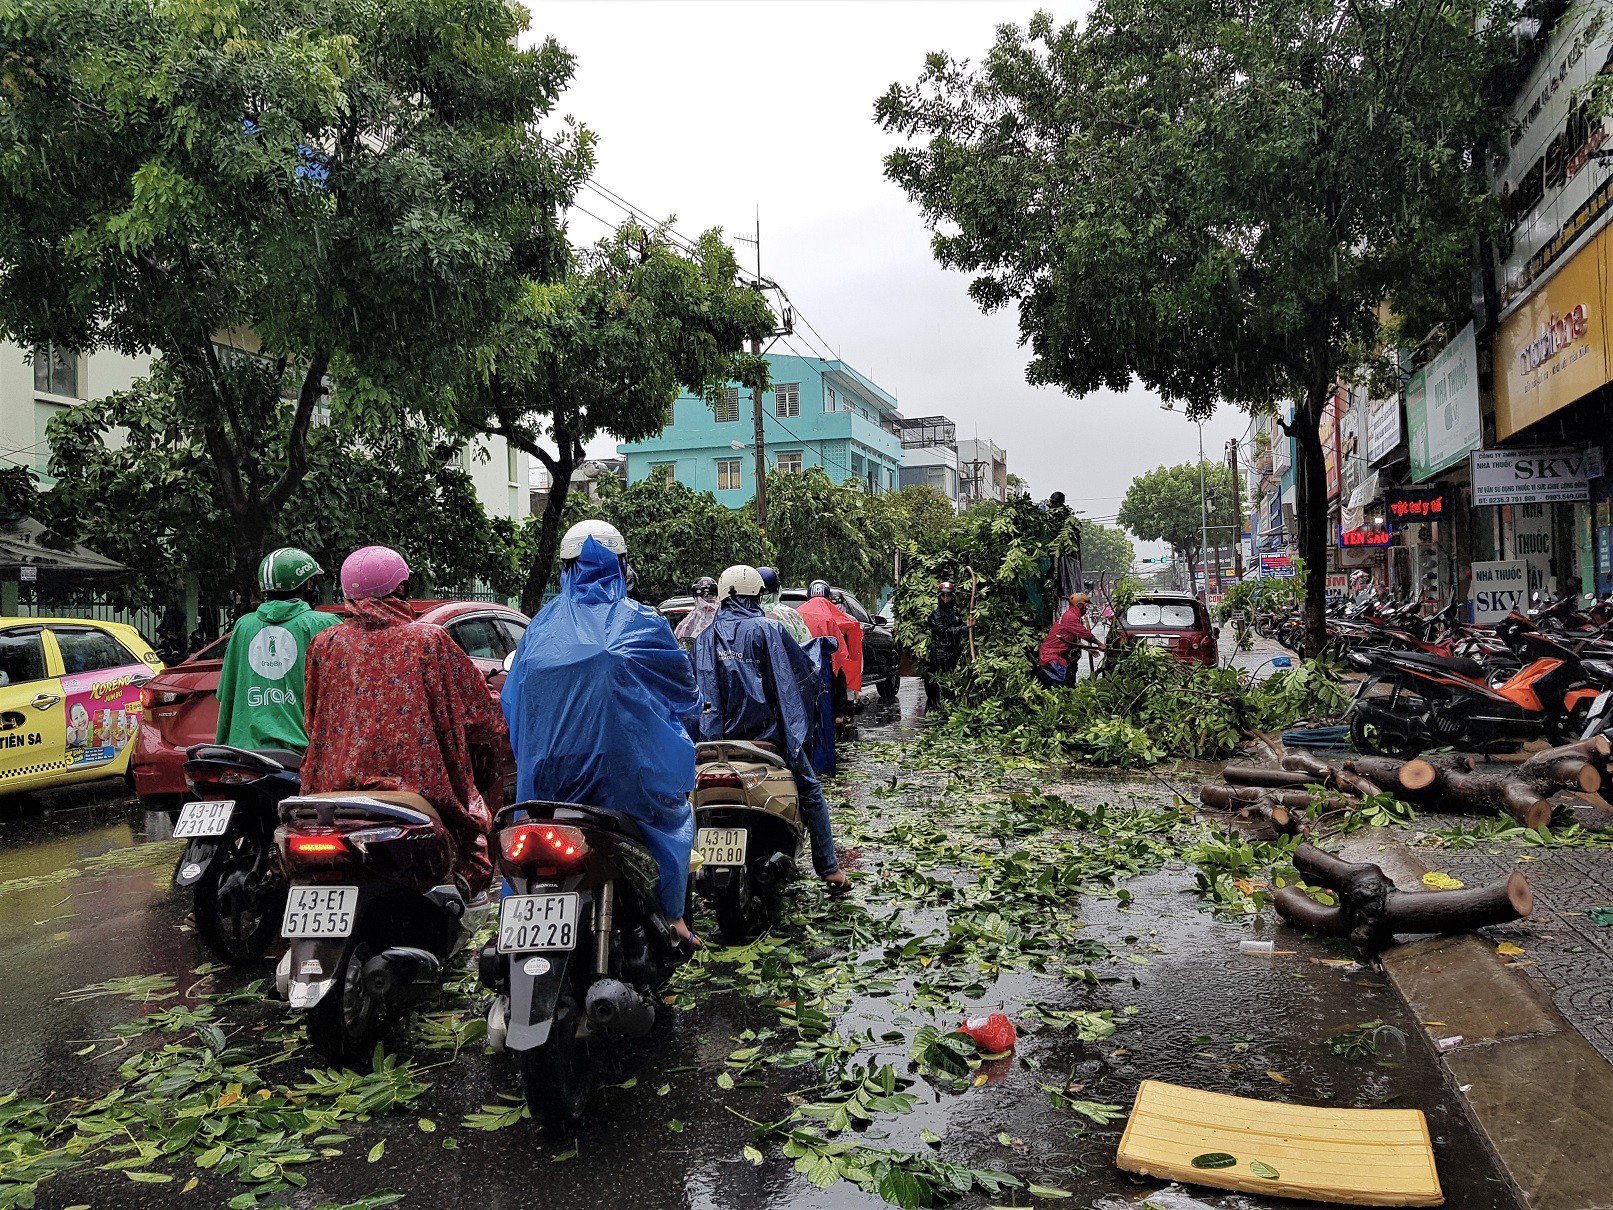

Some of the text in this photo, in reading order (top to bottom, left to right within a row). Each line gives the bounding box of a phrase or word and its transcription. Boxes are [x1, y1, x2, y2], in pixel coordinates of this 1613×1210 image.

[1492, 459, 1513, 468] THUỐC
[1514, 457, 1584, 480] SKV
[1517, 526, 1549, 554] THUỐC
[295, 561, 313, 576] Grab
[1476, 564, 1521, 581] NHÀ THUỐC
[1476, 590, 1523, 612] SKV
[0, 733, 42, 749] TIÊN SA
[188, 803, 225, 818] 43-D1
[178, 818, 226, 835] 731.40
[705, 831, 738, 845] 43-D1
[700, 847, 742, 862] 376.80
[298, 890, 345, 910] 43-E1
[513, 897, 565, 922] 43-F1
[288, 912, 350, 933] 515.55
[503, 923, 572, 949] 202.28
